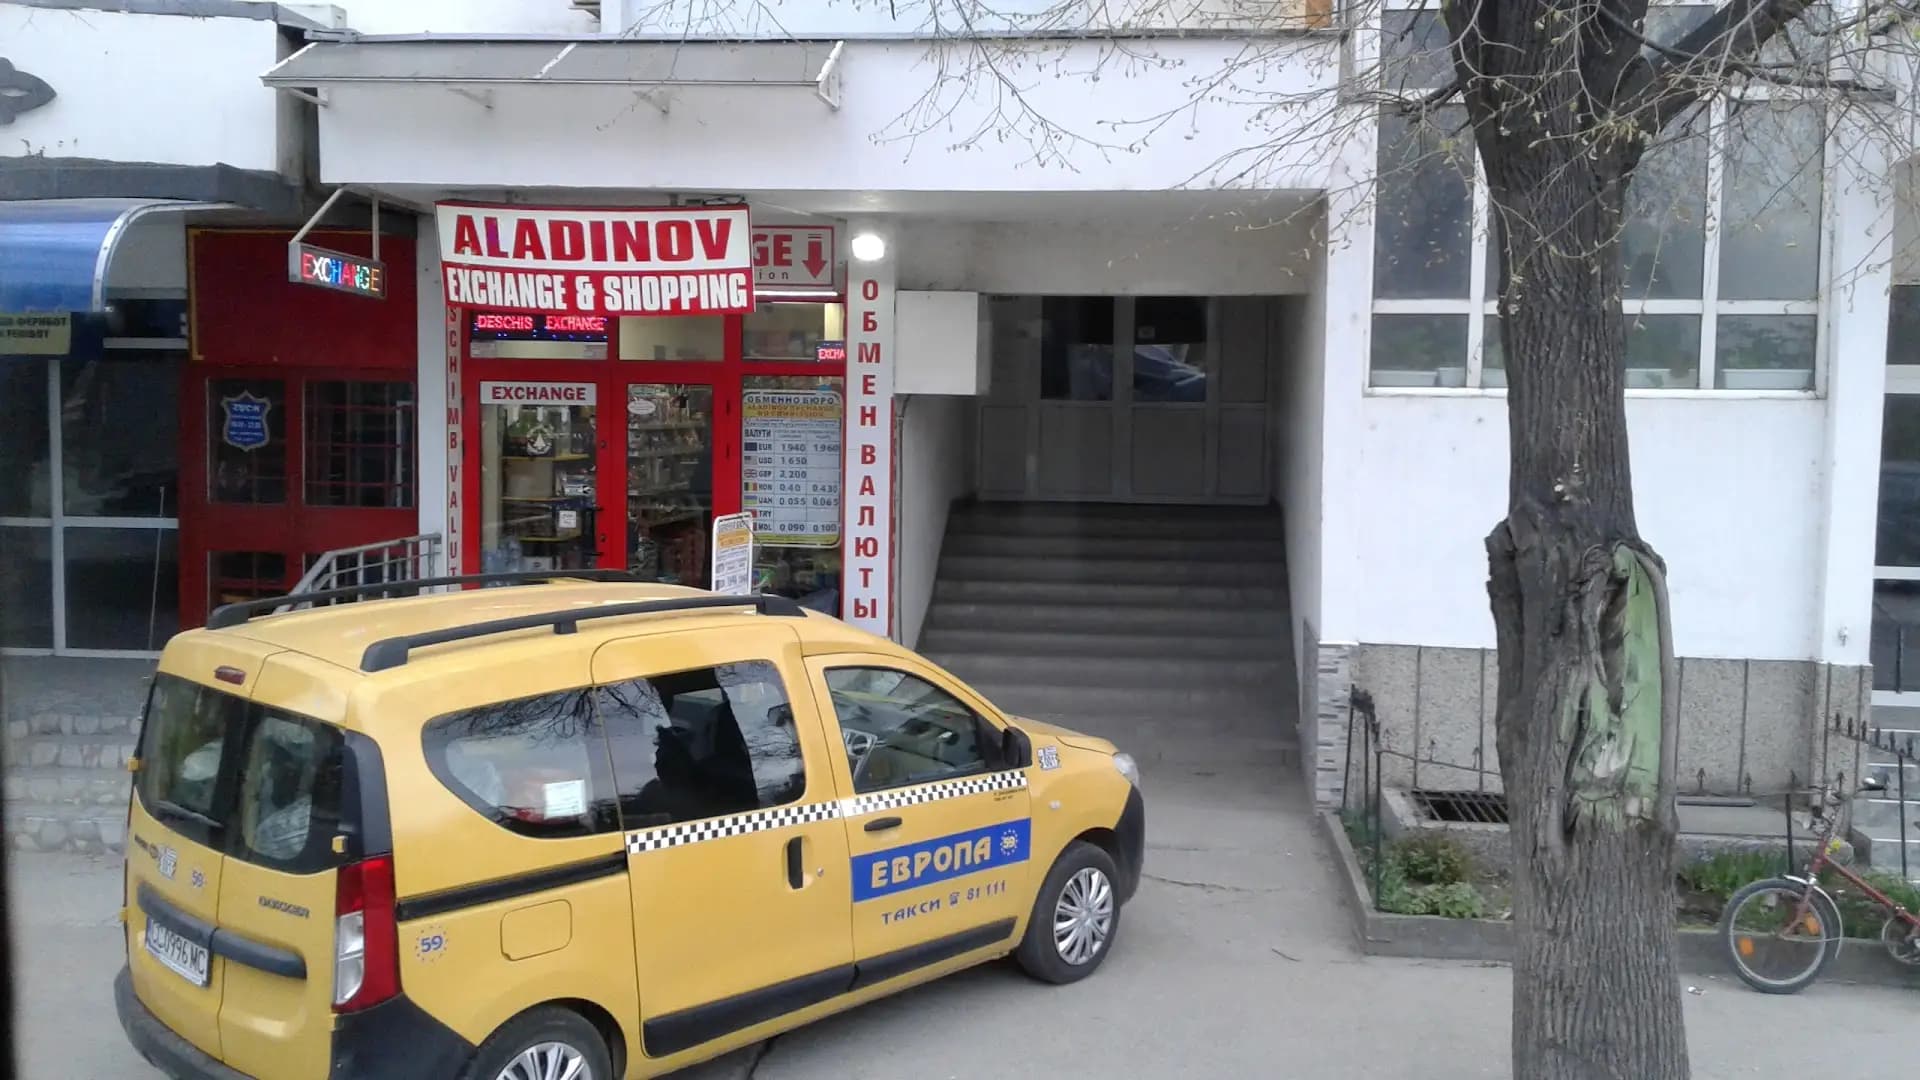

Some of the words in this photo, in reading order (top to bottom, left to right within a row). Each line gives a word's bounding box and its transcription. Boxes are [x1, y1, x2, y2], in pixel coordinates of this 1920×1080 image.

[453, 214, 732, 263] ALADINOV
[302, 253, 380, 291] EXCHANGE
[446, 267, 567, 310] EXCHANGE
[575, 275, 596, 310] &
[603, 273, 747, 312] SHOPPING
[477, 315, 534, 330] DESCHIS
[545, 316, 605, 331] EXCHANGE
[858, 279, 881, 427] ОБМЕН
[448, 307, 459, 450] SCHIMB
[491, 386, 587, 401] EXCHANGE
[747, 396, 800, 405] ОБМЕННО
[803, 396, 834, 405] БЮРО
[744, 429, 772, 438] ВАЛУТИ
[758, 443, 772, 451] EUR
[854, 444, 879, 620] ВАЛЮТЫ
[871, 836, 991, 889] ЕВРОПА
[881, 898, 941, 925] ТАКСИ
[420, 935, 444, 953] 59
